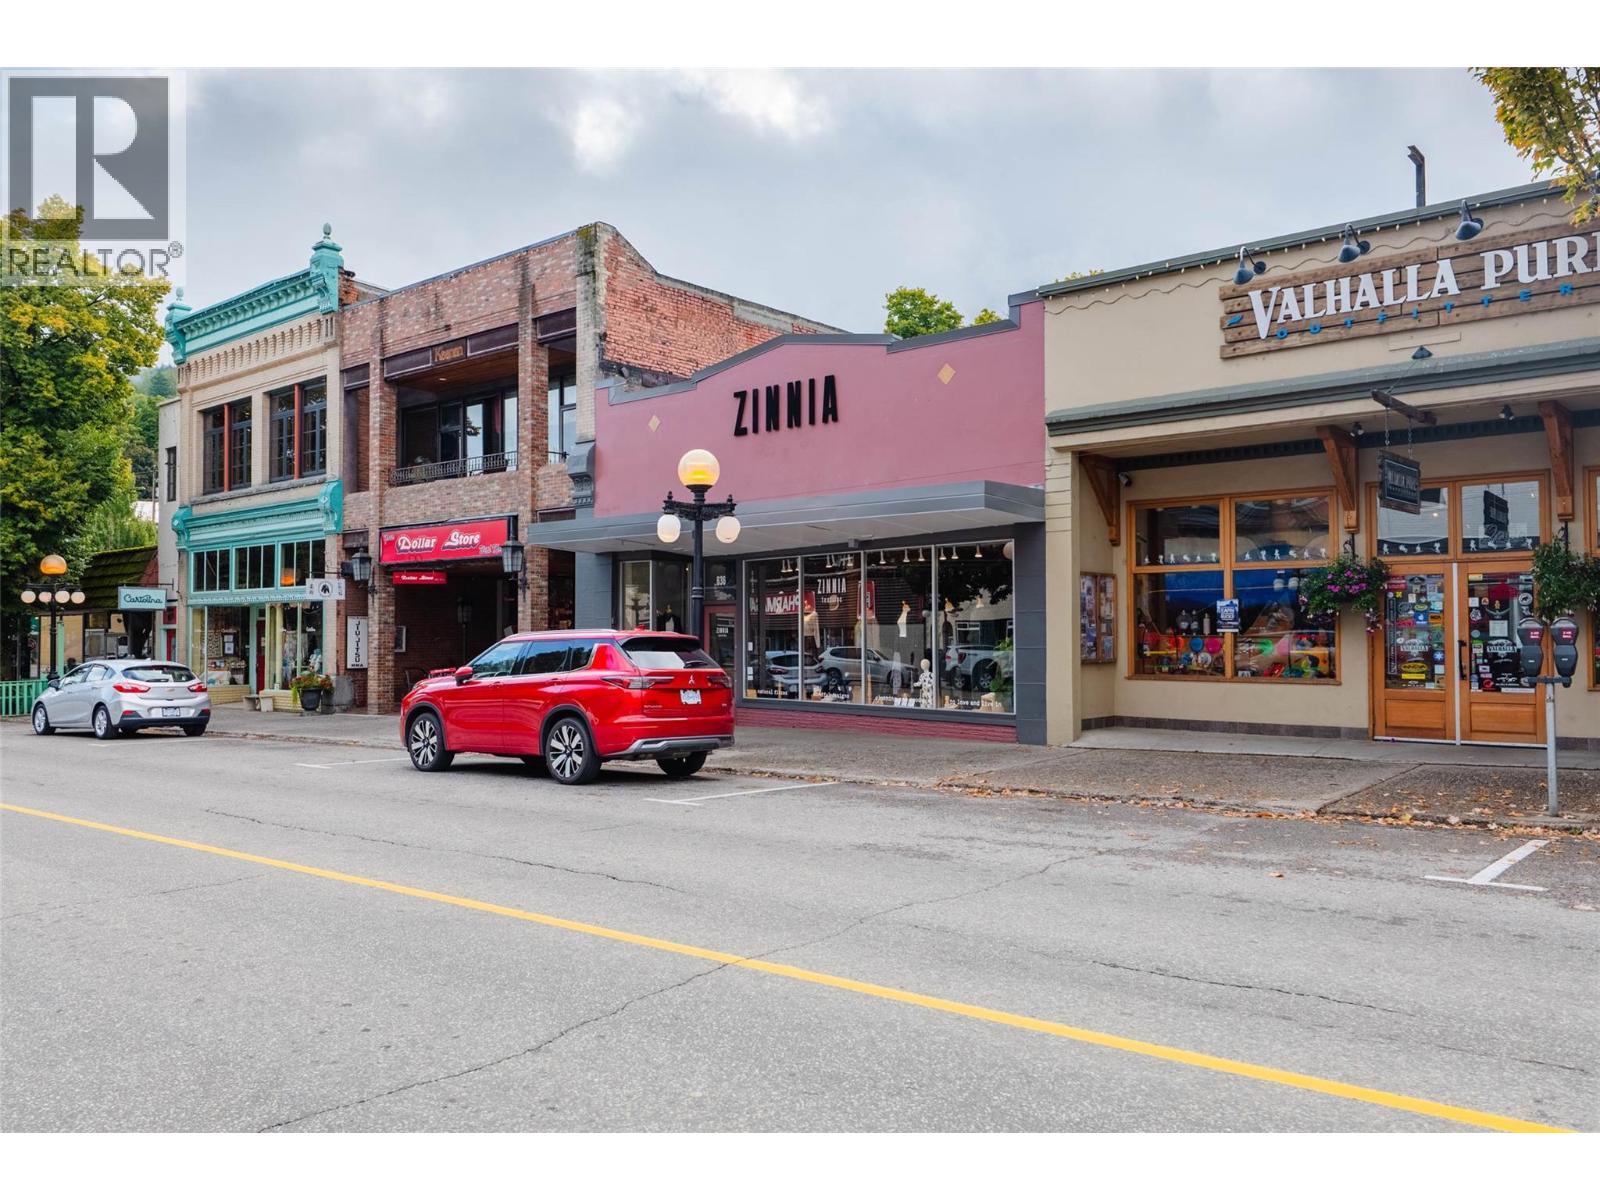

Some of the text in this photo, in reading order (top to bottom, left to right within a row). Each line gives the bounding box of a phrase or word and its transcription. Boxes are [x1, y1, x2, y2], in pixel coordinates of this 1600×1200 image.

[1249, 258, 1461, 340] VALHALLA
[733, 374, 839, 437] ZINNIA
[396, 535, 437, 554] Dollar
[441, 530, 481, 551] Store
[817, 577, 847, 594] ZINNIA
[123, 593, 163, 603] Cartolina
